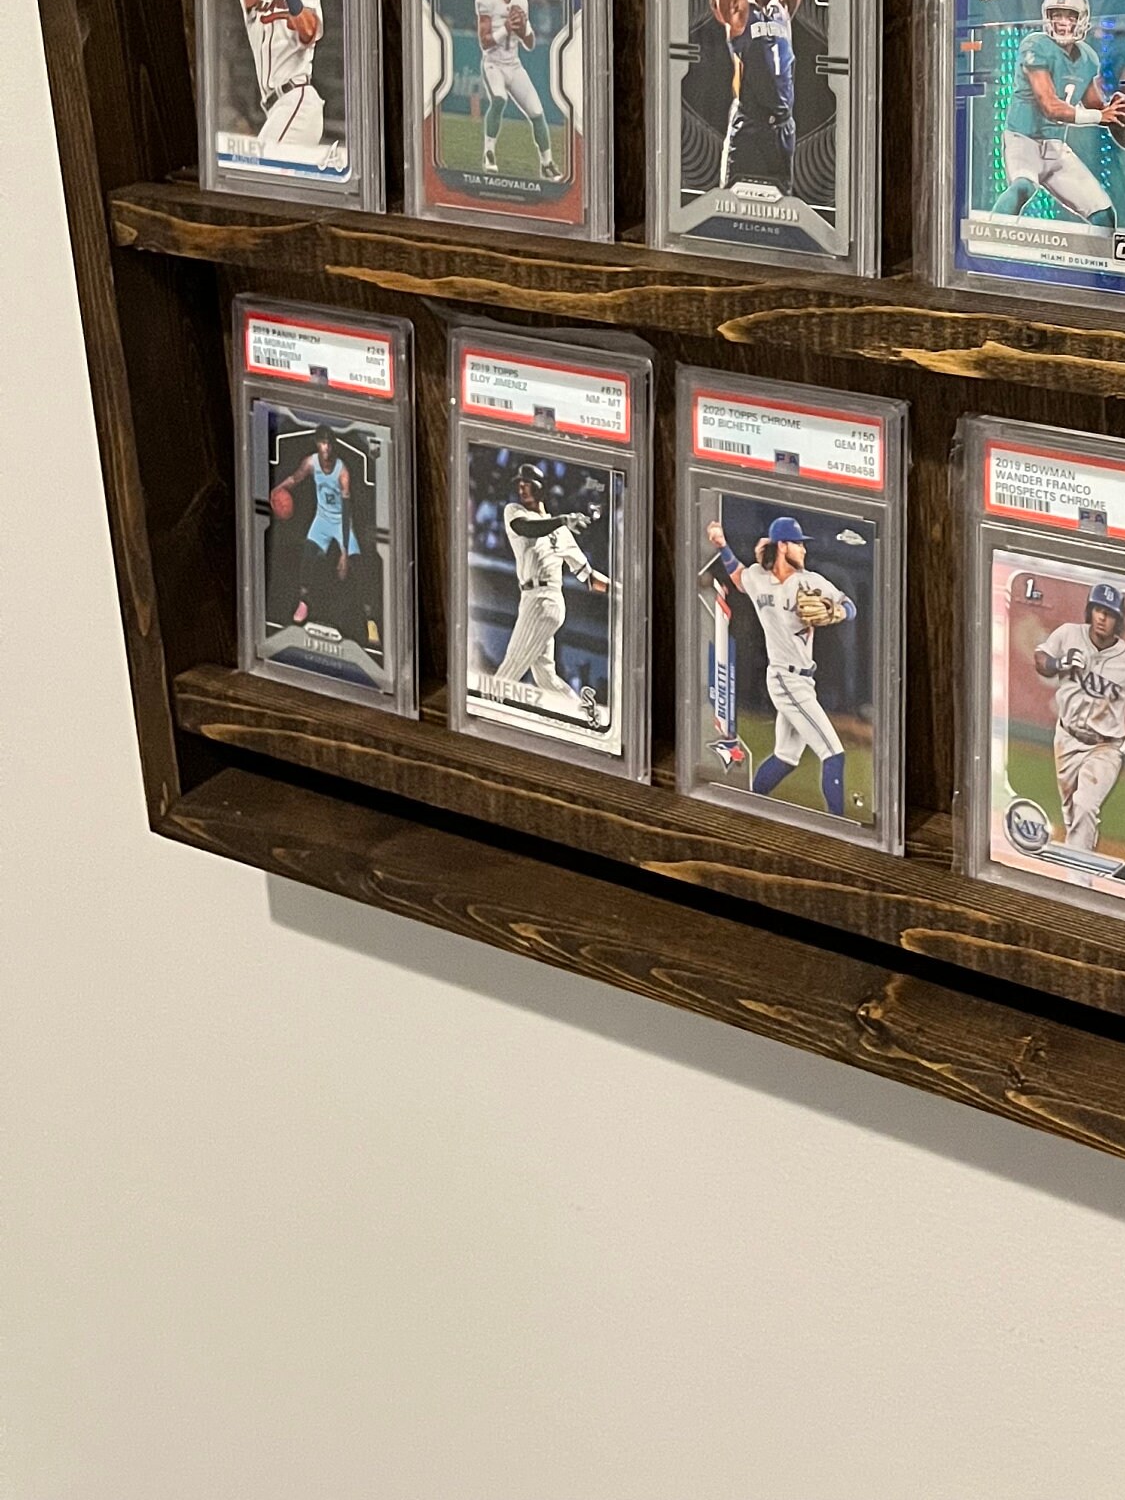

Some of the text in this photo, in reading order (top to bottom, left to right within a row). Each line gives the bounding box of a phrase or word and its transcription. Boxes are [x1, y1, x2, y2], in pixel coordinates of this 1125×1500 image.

[227, 140, 265, 159] RILEY
[463, 173, 541, 191] TUA TAGOVAILOA
[715, 199, 800, 222] ZION WILLIAMSON
[733, 222, 780, 235] PELICANS
[969, 225, 1068, 247] TUA TAGOVAILOA
[1041, 253, 1109, 268] MIAMI DOLPHINS
[493, 365, 518, 378] TOPPS
[703, 405, 800, 429] 2020 TOPPS CHROME
[703, 416, 761, 434] BO BICHETTE
[851, 431, 875, 442] #150
[834, 439, 874, 454] GEM MT
[864, 456, 874, 465] 10
[995, 457, 1076, 481] 2019 BOWMAN
[995, 470, 1091, 495] WANDER FRANCO
[995, 482, 1106, 511] PROSPECTS CHROME
[477, 674, 544, 706] JIMENEZ
[717, 662, 727, 720] BICHETTE
